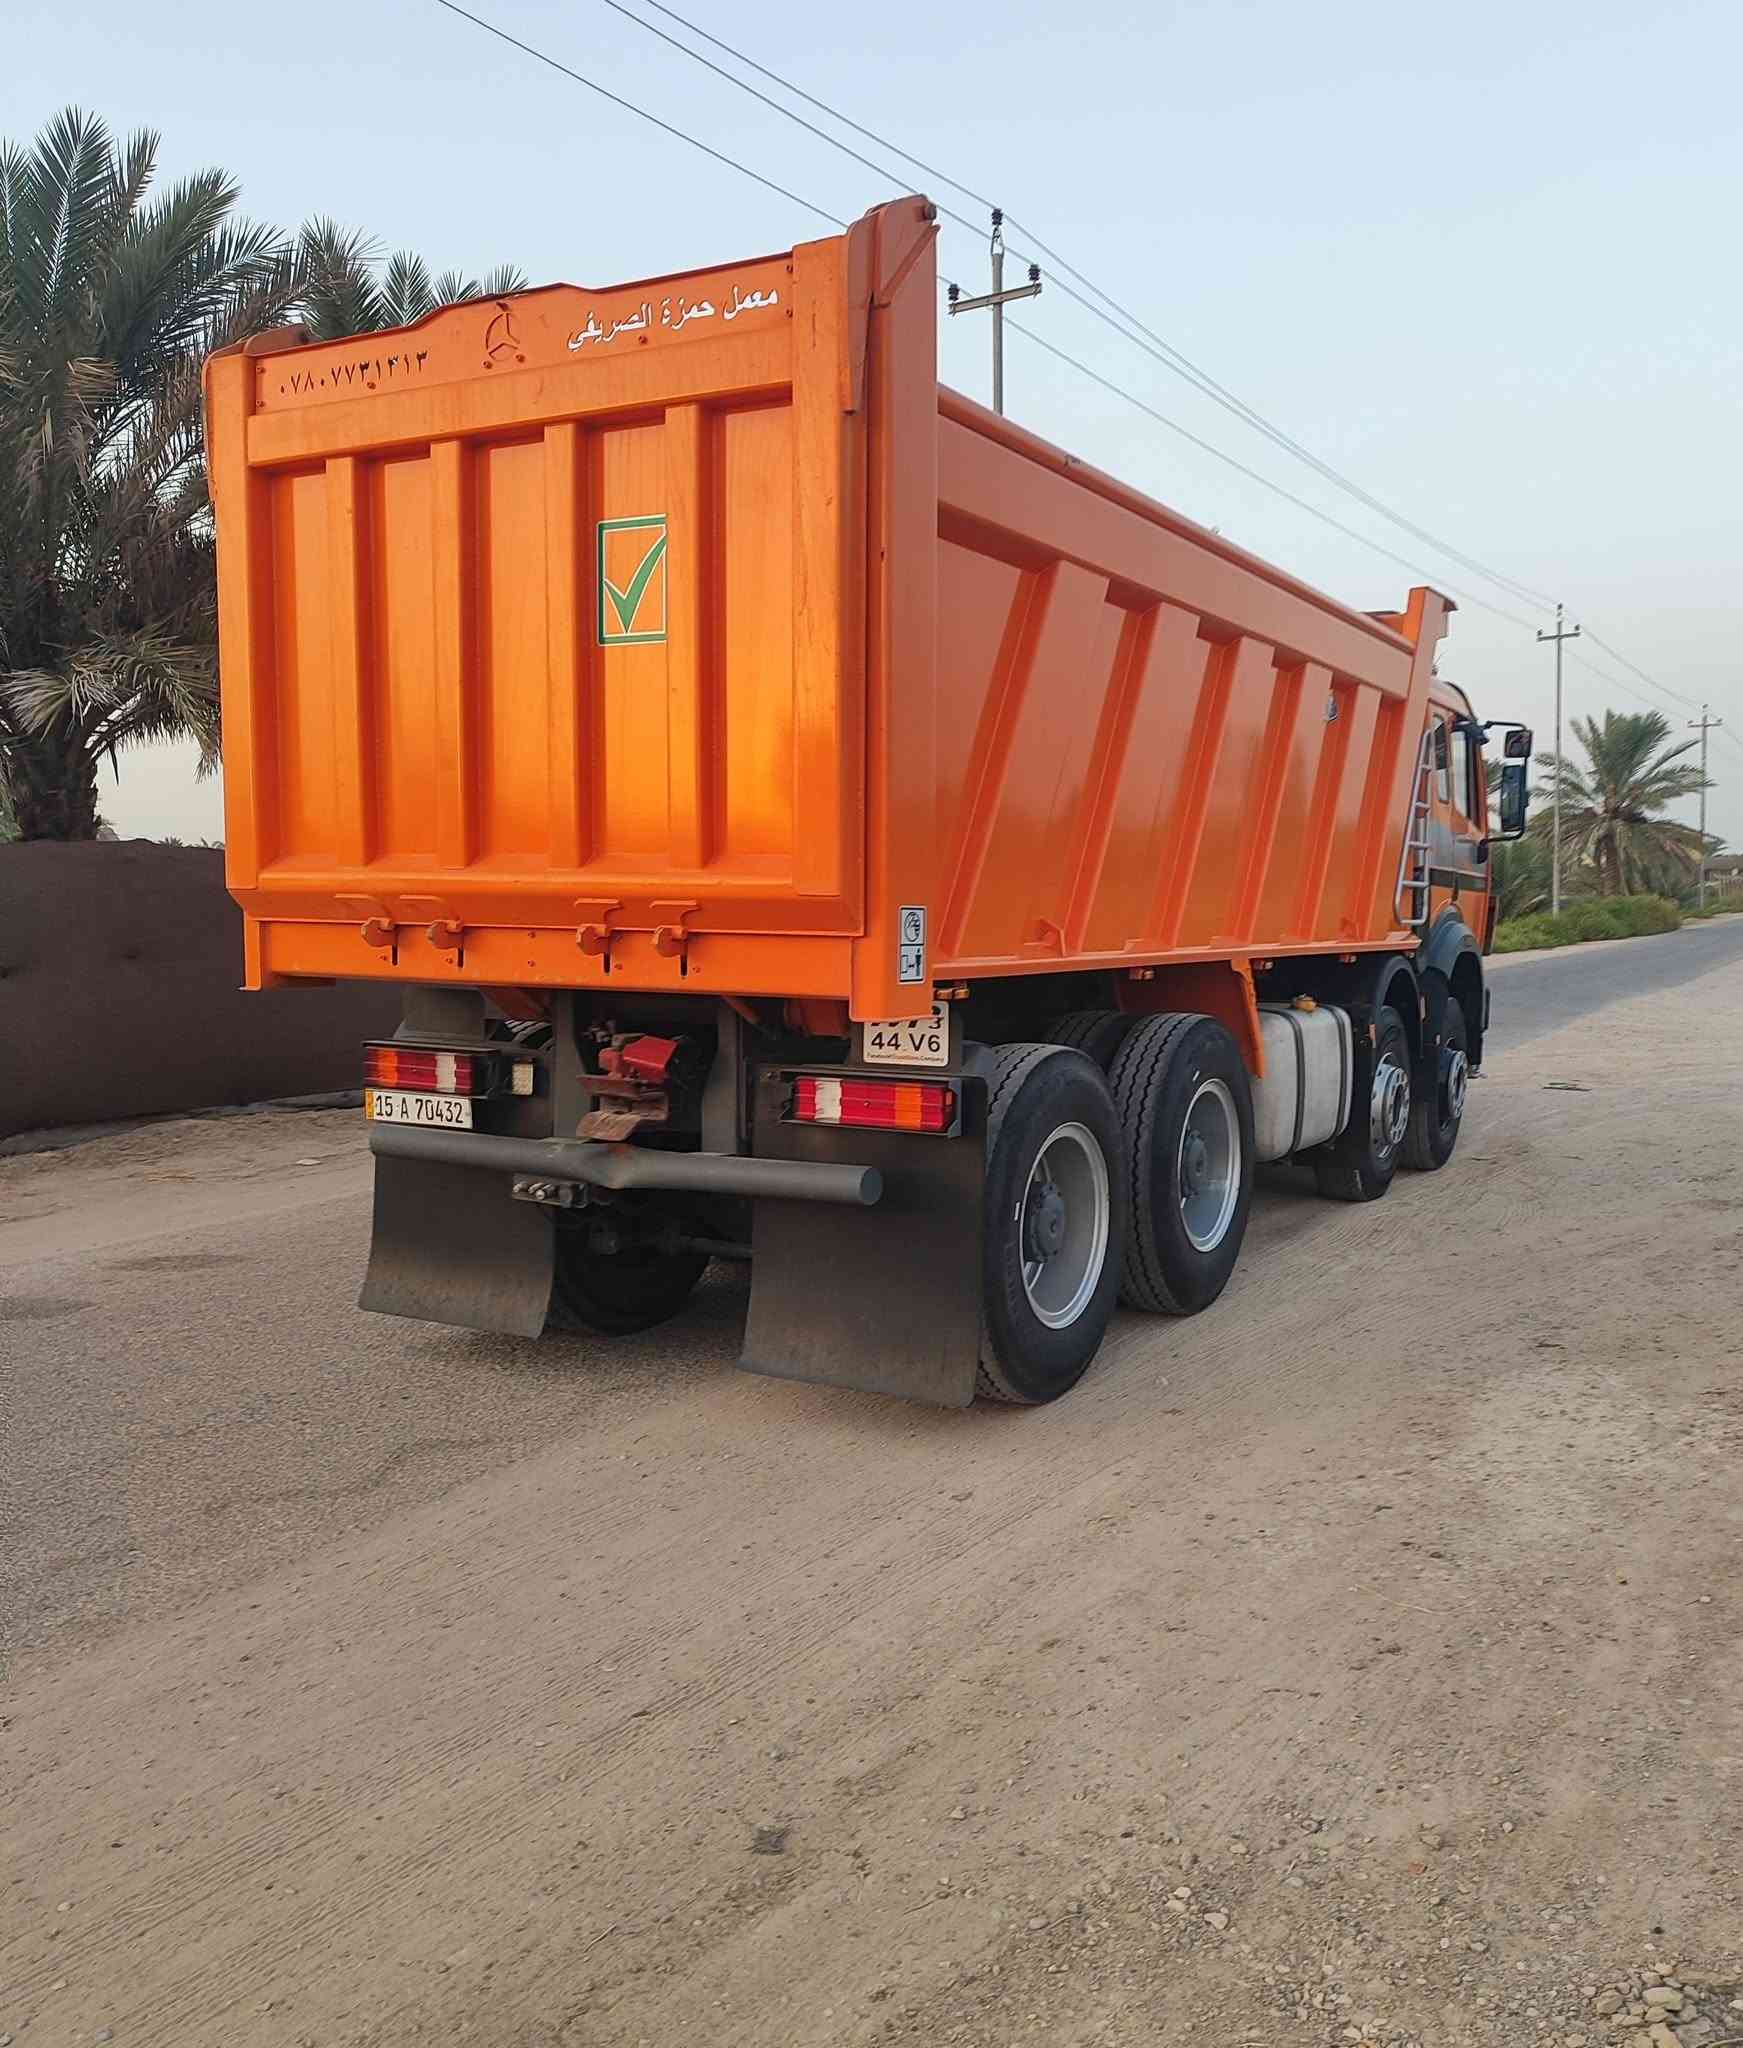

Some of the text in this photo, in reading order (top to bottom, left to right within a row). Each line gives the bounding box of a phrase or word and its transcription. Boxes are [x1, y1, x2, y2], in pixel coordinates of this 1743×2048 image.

[660, 297, 715, 330] حمزة
[723, 284, 778, 320] معمل
[871, 1031, 940, 1053] 44 V6
[376, 1094, 393, 1117] 15
[400, 1096, 409, 1119] A
[415, 1098, 464, 1124] 70432
